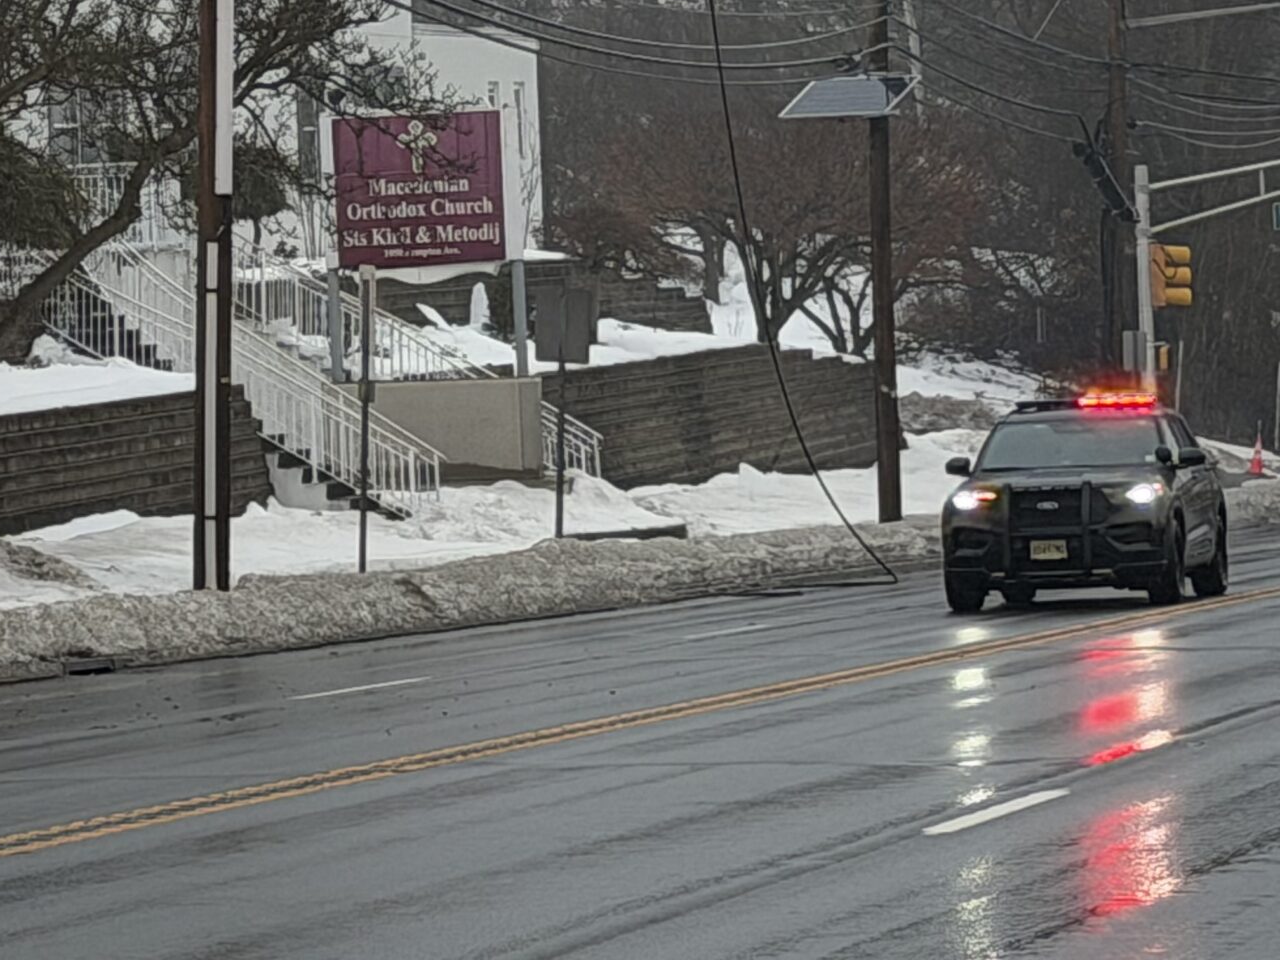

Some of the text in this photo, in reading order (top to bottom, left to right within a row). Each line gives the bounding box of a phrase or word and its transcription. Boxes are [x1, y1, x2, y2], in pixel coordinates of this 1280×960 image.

[368, 176, 469, 196] Macedonian
[346, 196, 493, 221] Orthodox Church
[343, 229, 368, 247] Sts
[415, 226, 432, 243] &
[436, 222, 500, 244] Metodij
